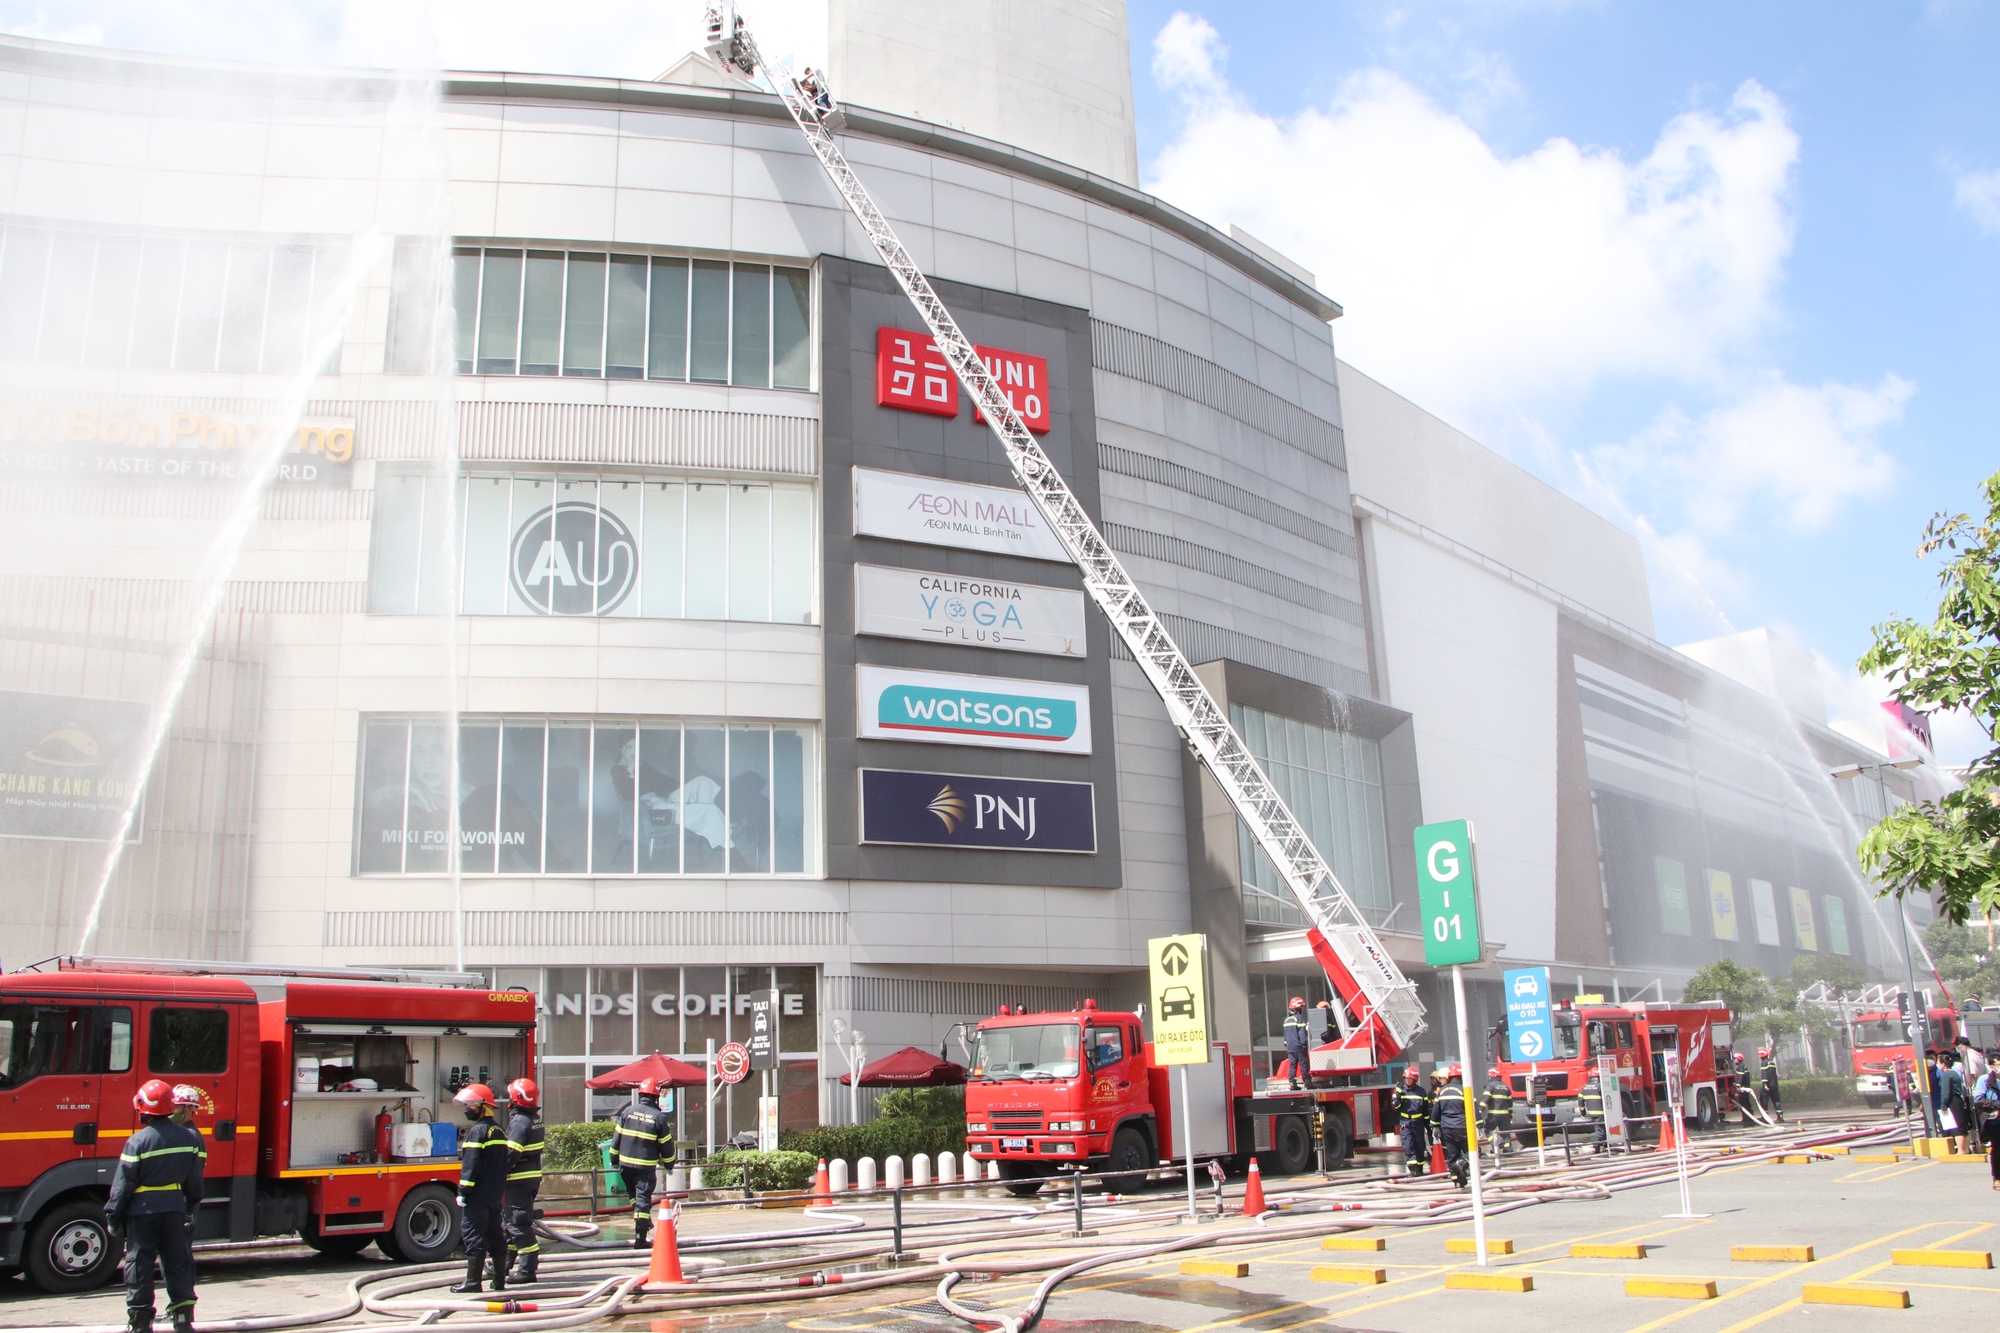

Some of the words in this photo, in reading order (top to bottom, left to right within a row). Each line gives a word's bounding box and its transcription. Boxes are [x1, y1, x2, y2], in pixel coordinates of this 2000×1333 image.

[985, 356, 1034, 389] UNI
[169, 412, 355, 463] Phưng
[95, 455, 154, 475] TASTE
[162, 459, 193, 475] OF
[199, 460, 236, 477] THE
[975, 502, 1036, 528] MALL
[952, 523, 980, 535] MALL
[1005, 529, 1022, 540] Tân
[920, 577, 1022, 600] CALIFORNIA
[945, 626, 1001, 643] PLUS
[904, 696, 1052, 730] watsons
[0, 773, 45, 794] CHANG
[53, 777, 90, 797] KANG
[73, 801, 97, 811] Hong
[974, 794, 1037, 841] PNJ
[382, 830, 419, 843] MIKI
[462, 831, 525, 845] WOMAN
[1427, 841, 1460, 882] G
[1433, 914, 1462, 942] 01
[488, 993, 529, 1003] GIMAEX
[651, 993, 804, 1016] COFFE
[753, 1001, 769, 1012] TAXI
[1168, 1032, 1178, 1043] RA
[1179, 1031, 1188, 1042] XE
[718, 1044, 748, 1061] HIGHLANDS
[720, 1071, 744, 1081] COFFEE
[987, 1101, 1044, 1109] MITSUBISHI
